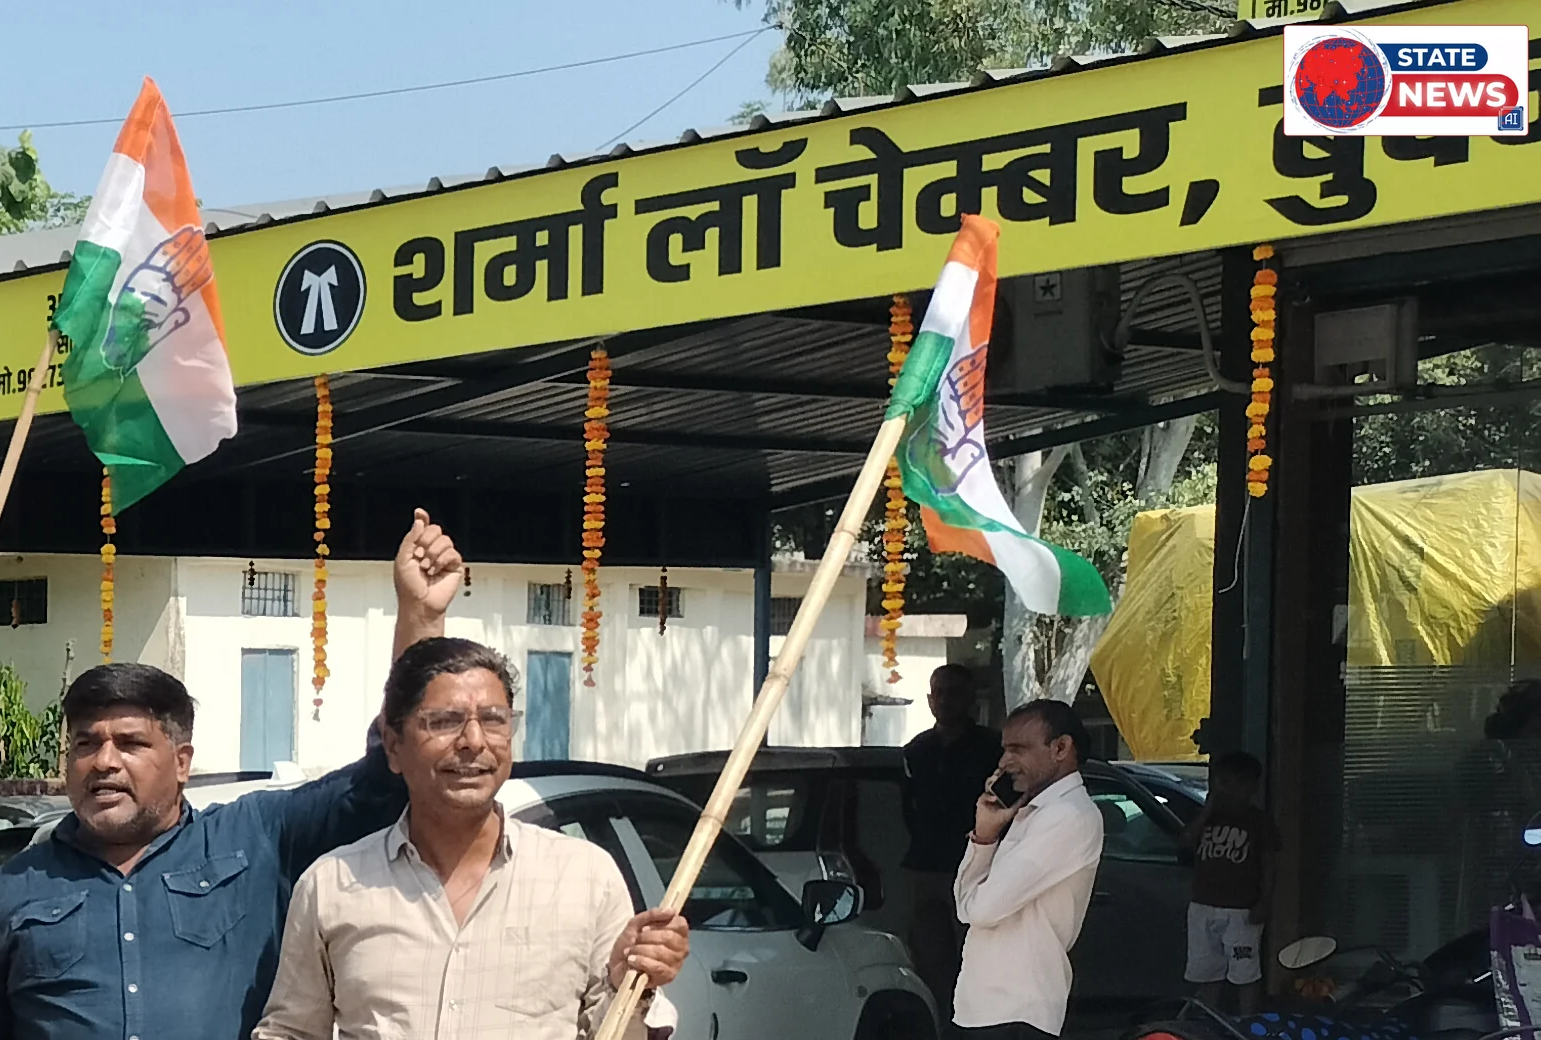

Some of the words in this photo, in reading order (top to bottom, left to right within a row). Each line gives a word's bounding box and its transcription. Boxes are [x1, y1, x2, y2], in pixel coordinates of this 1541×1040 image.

[393, 171, 619, 322] शर्मा
[635, 137, 808, 284] लॉ
[815, 102, 1220, 252] चेम्बर,
